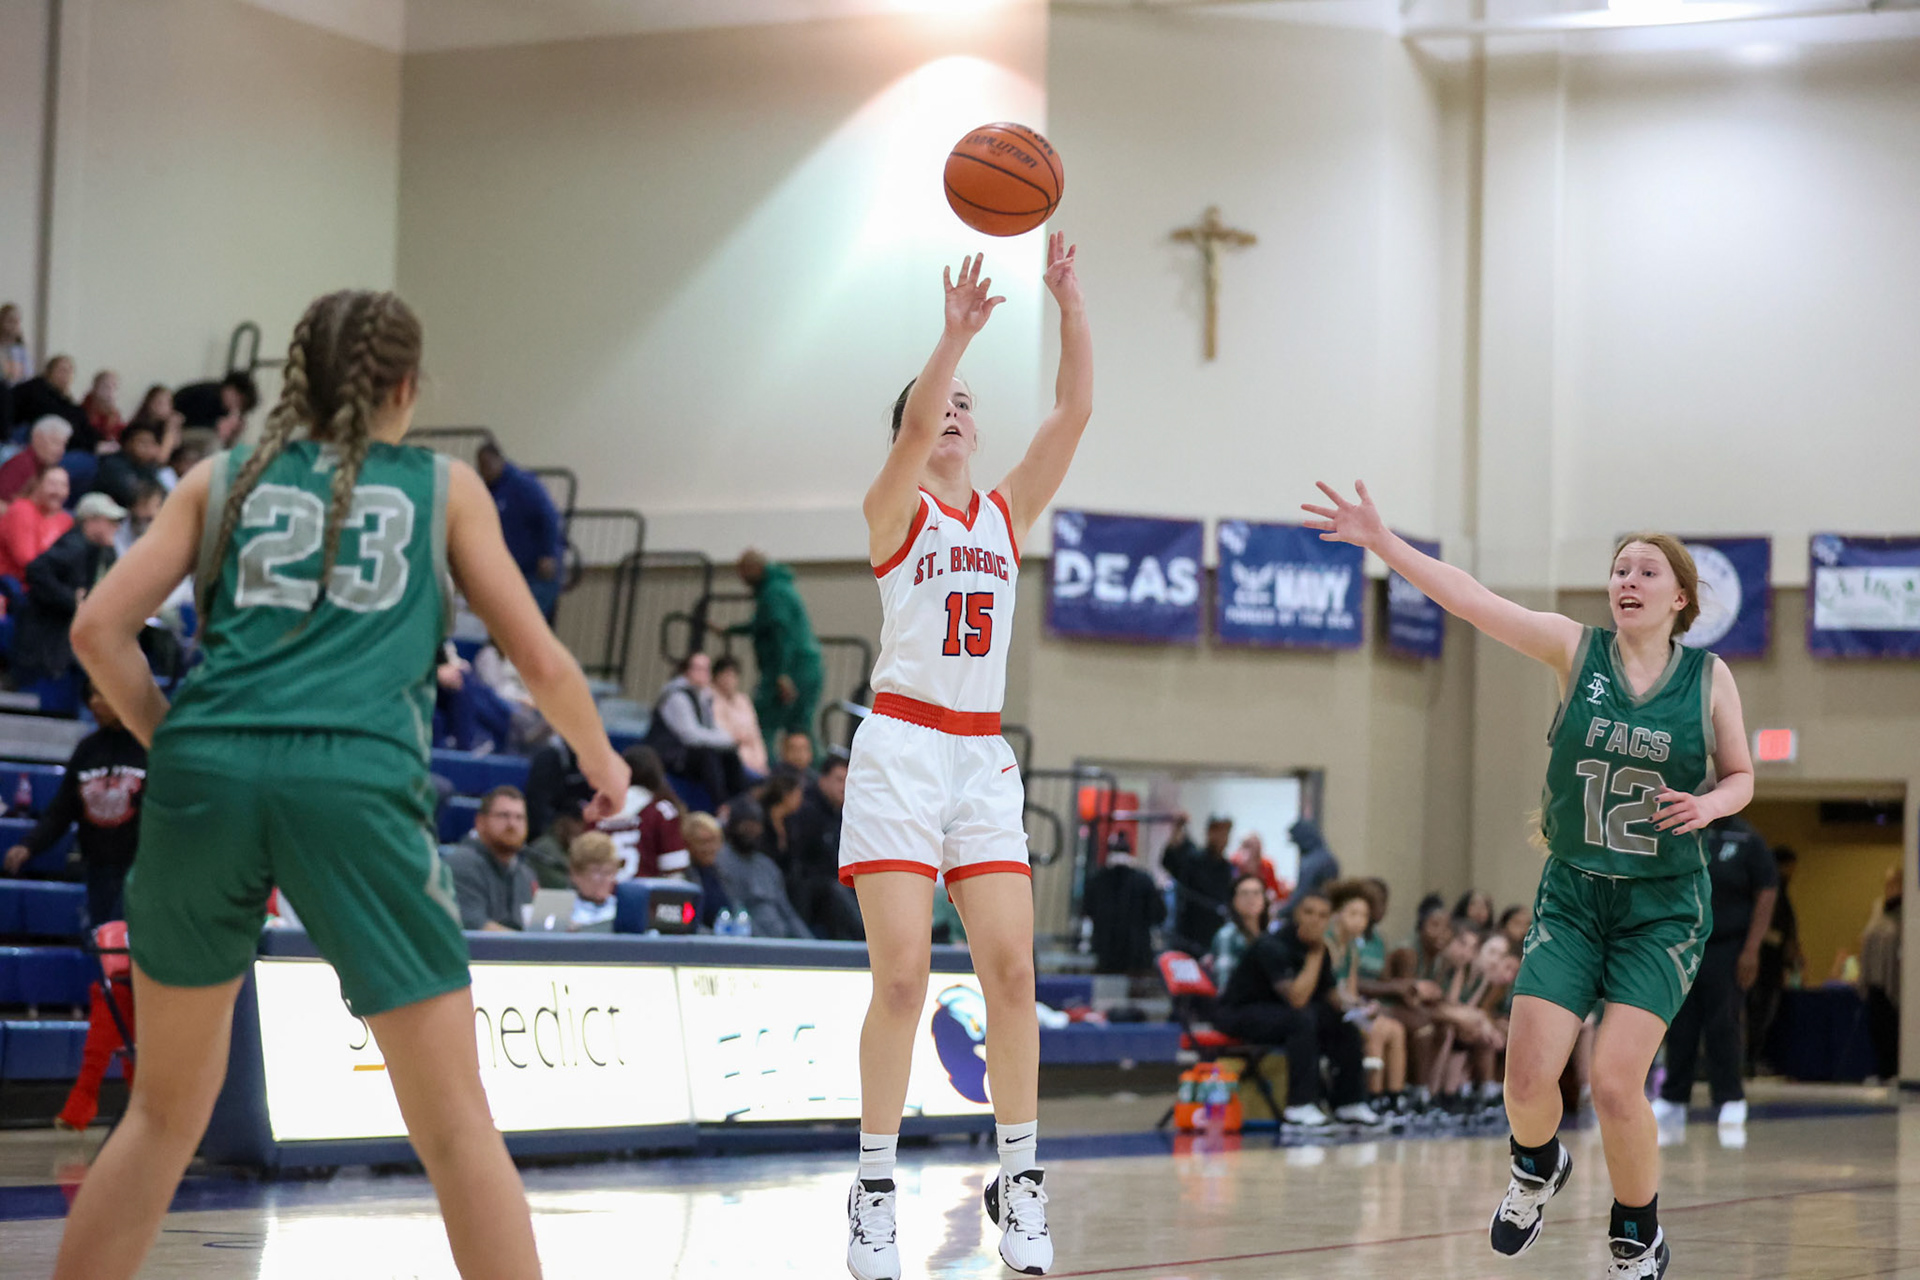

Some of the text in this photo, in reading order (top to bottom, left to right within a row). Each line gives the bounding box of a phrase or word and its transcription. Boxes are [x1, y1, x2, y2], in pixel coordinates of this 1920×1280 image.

[235, 483, 415, 612] 23
[914, 546, 1009, 586] ST. BNEDIC
[1054, 549, 1199, 607] DEAS
[942, 591, 994, 657] 15
[1585, 716, 1672, 763] FACS
[1576, 759, 1667, 856] 12
[473, 981, 625, 1069] nedict
